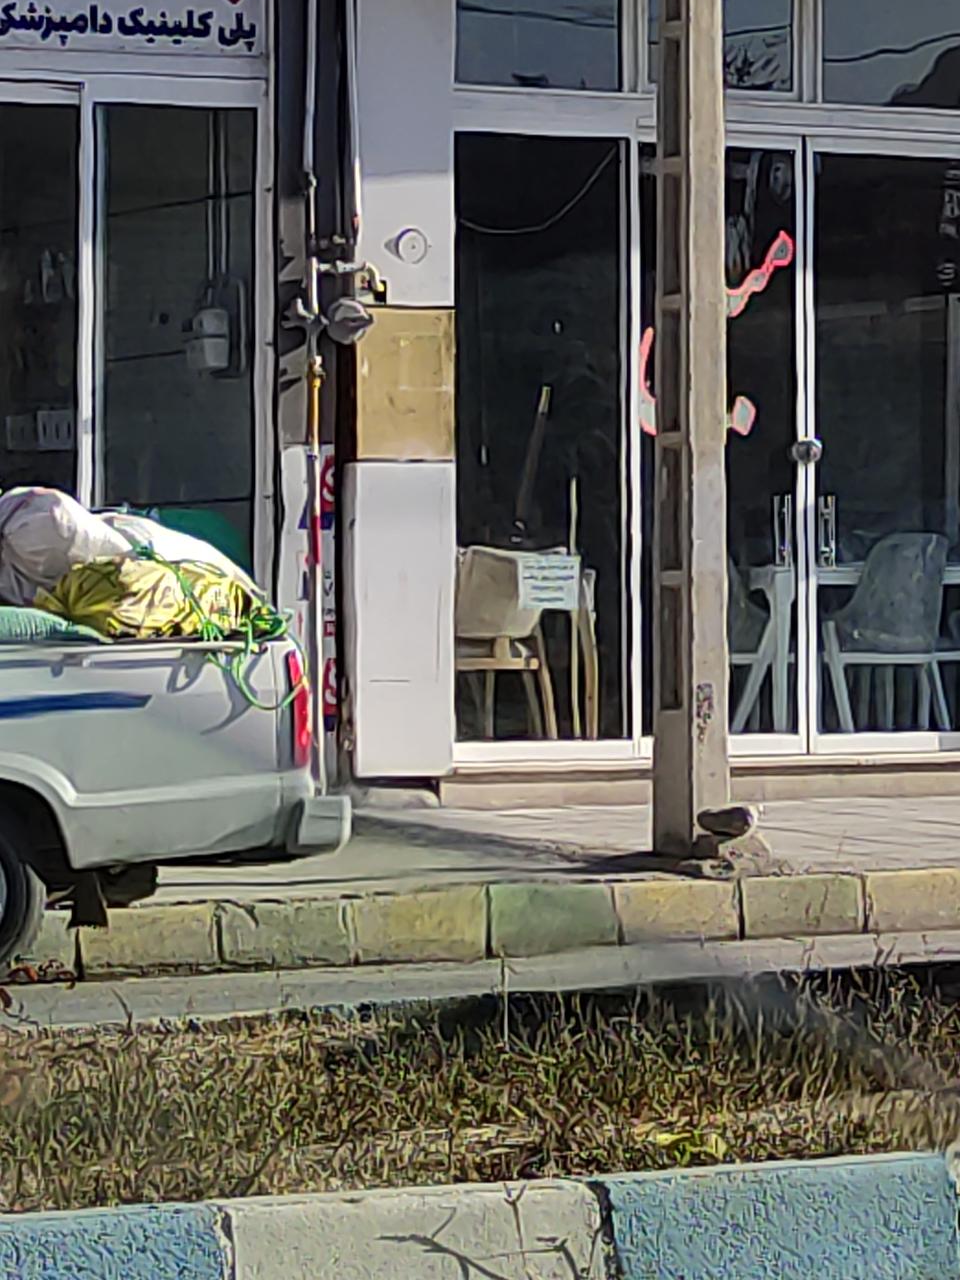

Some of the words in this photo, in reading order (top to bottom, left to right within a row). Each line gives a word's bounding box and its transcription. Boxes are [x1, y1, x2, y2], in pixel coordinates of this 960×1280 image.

[0, 1, 113, 47] دامپزشک
[117, 7, 214, 44] کلینیک
[217, 11, 257, 51] پلی
